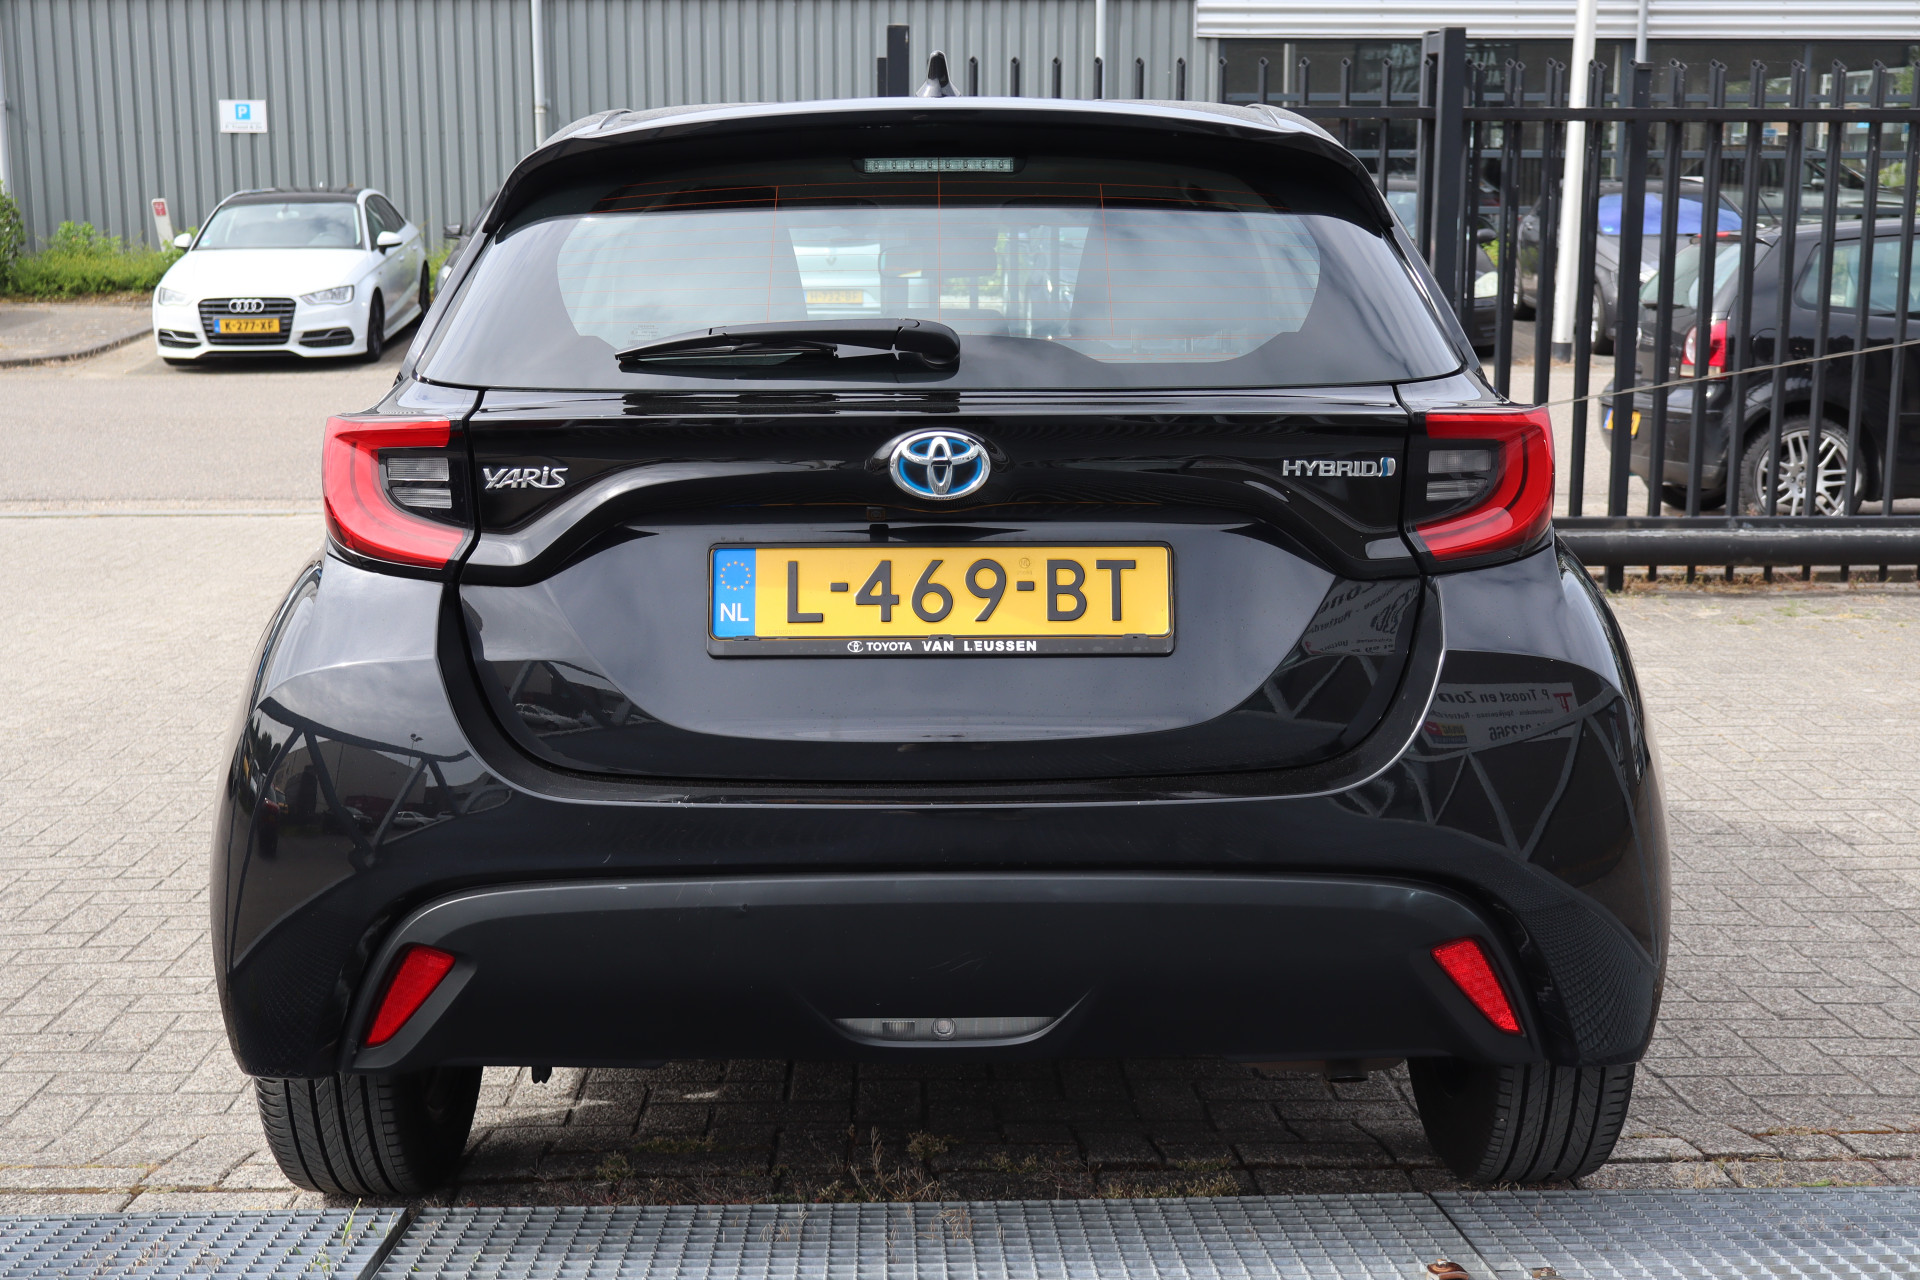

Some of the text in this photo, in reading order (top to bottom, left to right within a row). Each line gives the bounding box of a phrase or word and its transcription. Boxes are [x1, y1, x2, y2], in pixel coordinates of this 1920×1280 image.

[225, 321, 274, 331] K-277-XF
[1282, 459, 1378, 477] HYBRID
[787, 558, 1136, 623] L-469-BT
[720, 603, 749, 621] NL
[866, 640, 1037, 652] TOYOTA VAN LEUSSEN
